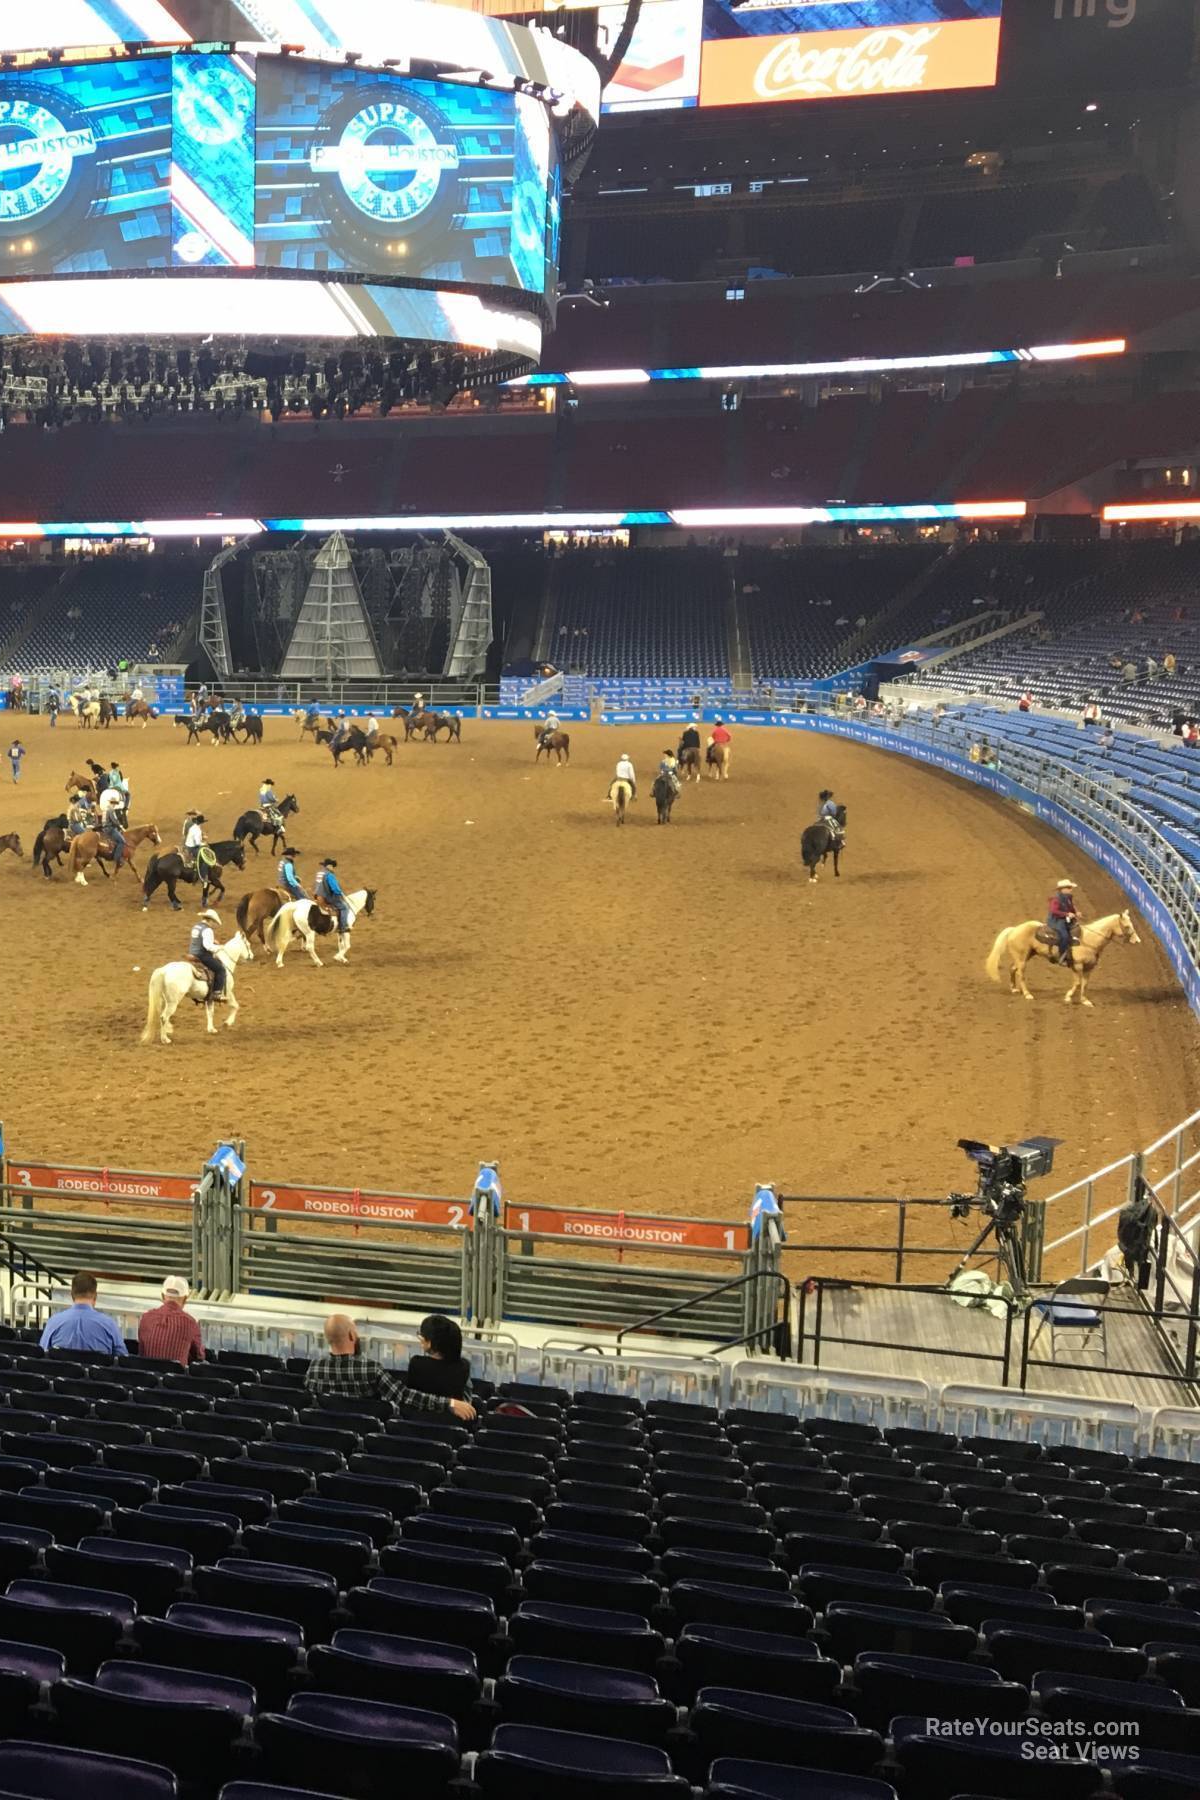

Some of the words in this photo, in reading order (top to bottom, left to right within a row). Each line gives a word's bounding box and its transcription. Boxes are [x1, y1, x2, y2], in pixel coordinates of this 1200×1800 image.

[348, 103, 426, 135] SUPER
[17, 1170, 32, 1188] 3
[57, 1179, 160, 1196] RODEOHOUSTON
[260, 1190, 276, 1210] 2
[304, 1200, 415, 1219] RODEOHOUSTON
[447, 1206, 465, 1227] 2
[519, 1212, 530, 1231] 1
[564, 1223, 684, 1243] RODEOHOUSTON
[723, 1230, 735, 1250] 1
